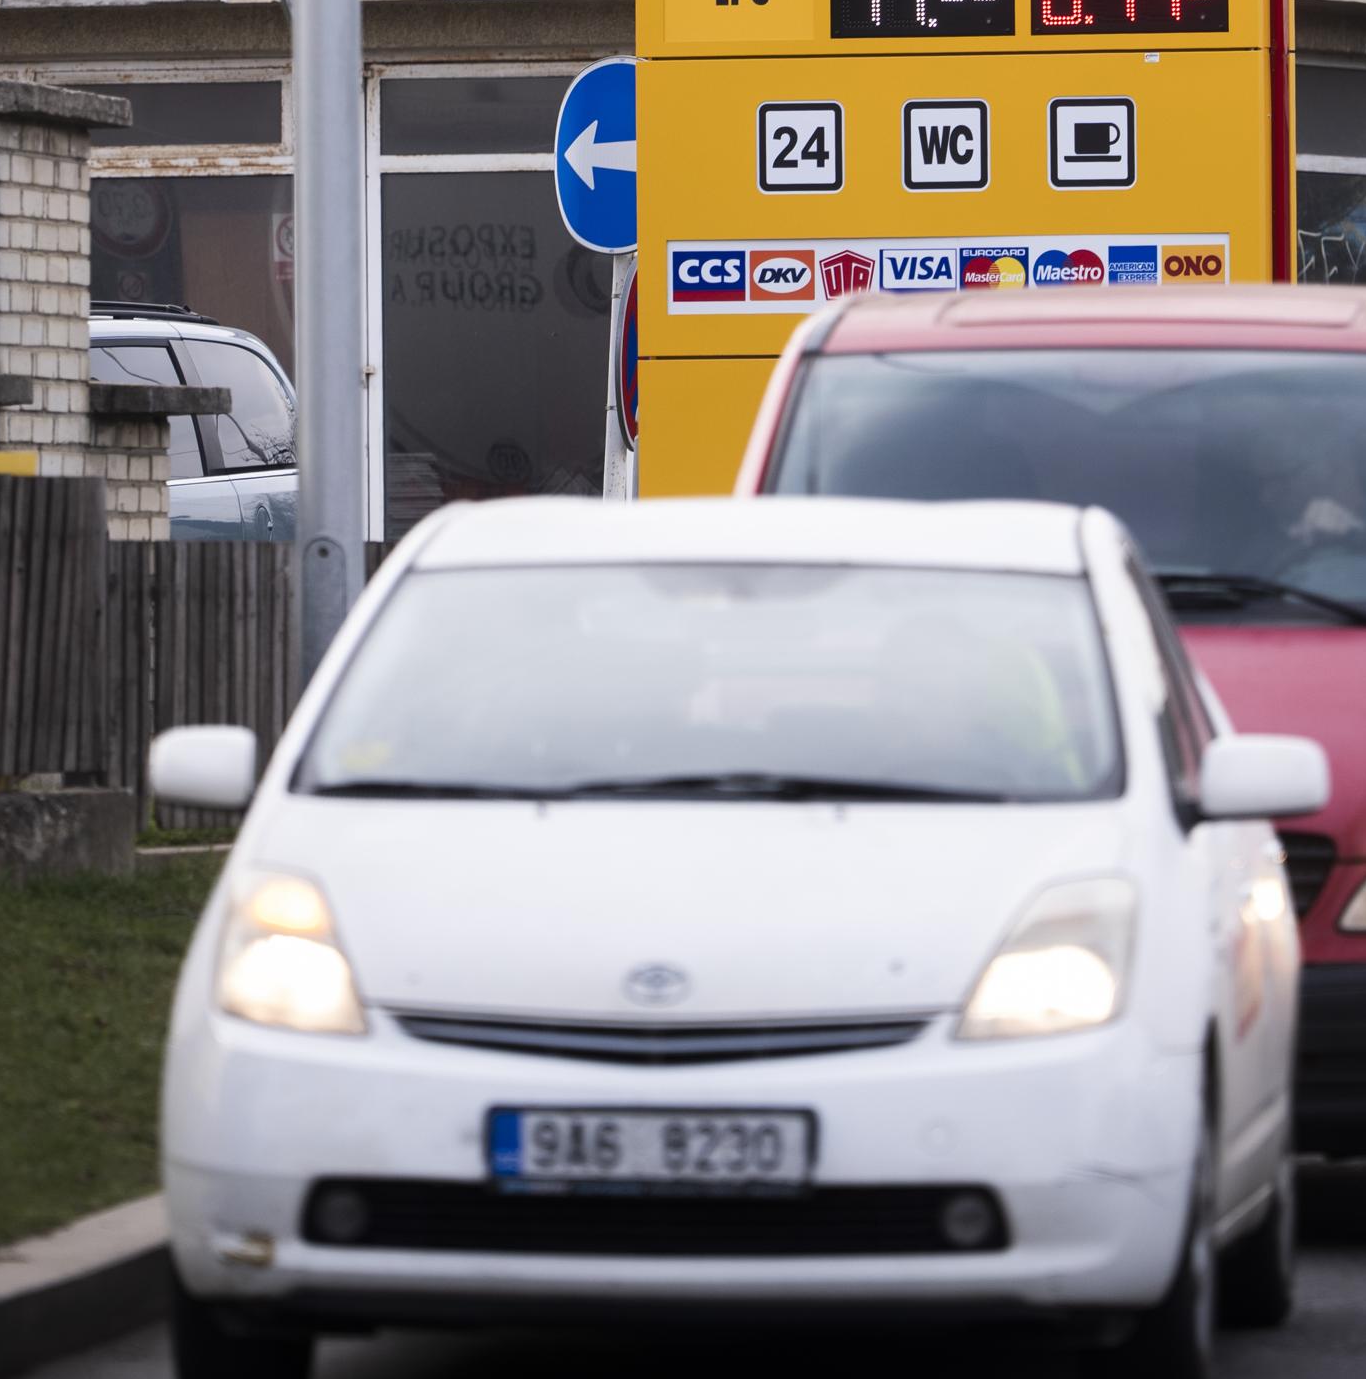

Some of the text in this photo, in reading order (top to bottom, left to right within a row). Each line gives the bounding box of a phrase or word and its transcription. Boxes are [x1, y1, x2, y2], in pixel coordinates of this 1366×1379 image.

[771, 125, 830, 169] 24
[918, 124, 975, 166] WC
[962, 248, 1026, 257] EUROCARD
[677, 258, 741, 284] CCS
[757, 267, 808, 284] DKV
[884, 255, 954, 281] VISA
[1036, 263, 1102, 281] Maestro
[1108, 262, 1154, 271] AMERICAN
[1164, 254, 1222, 278] ONO
[964, 271, 1024, 284] MasterCard
[1117, 273, 1158, 282] EXPRESS
[532, 1120, 786, 1173] 9A6 8230
